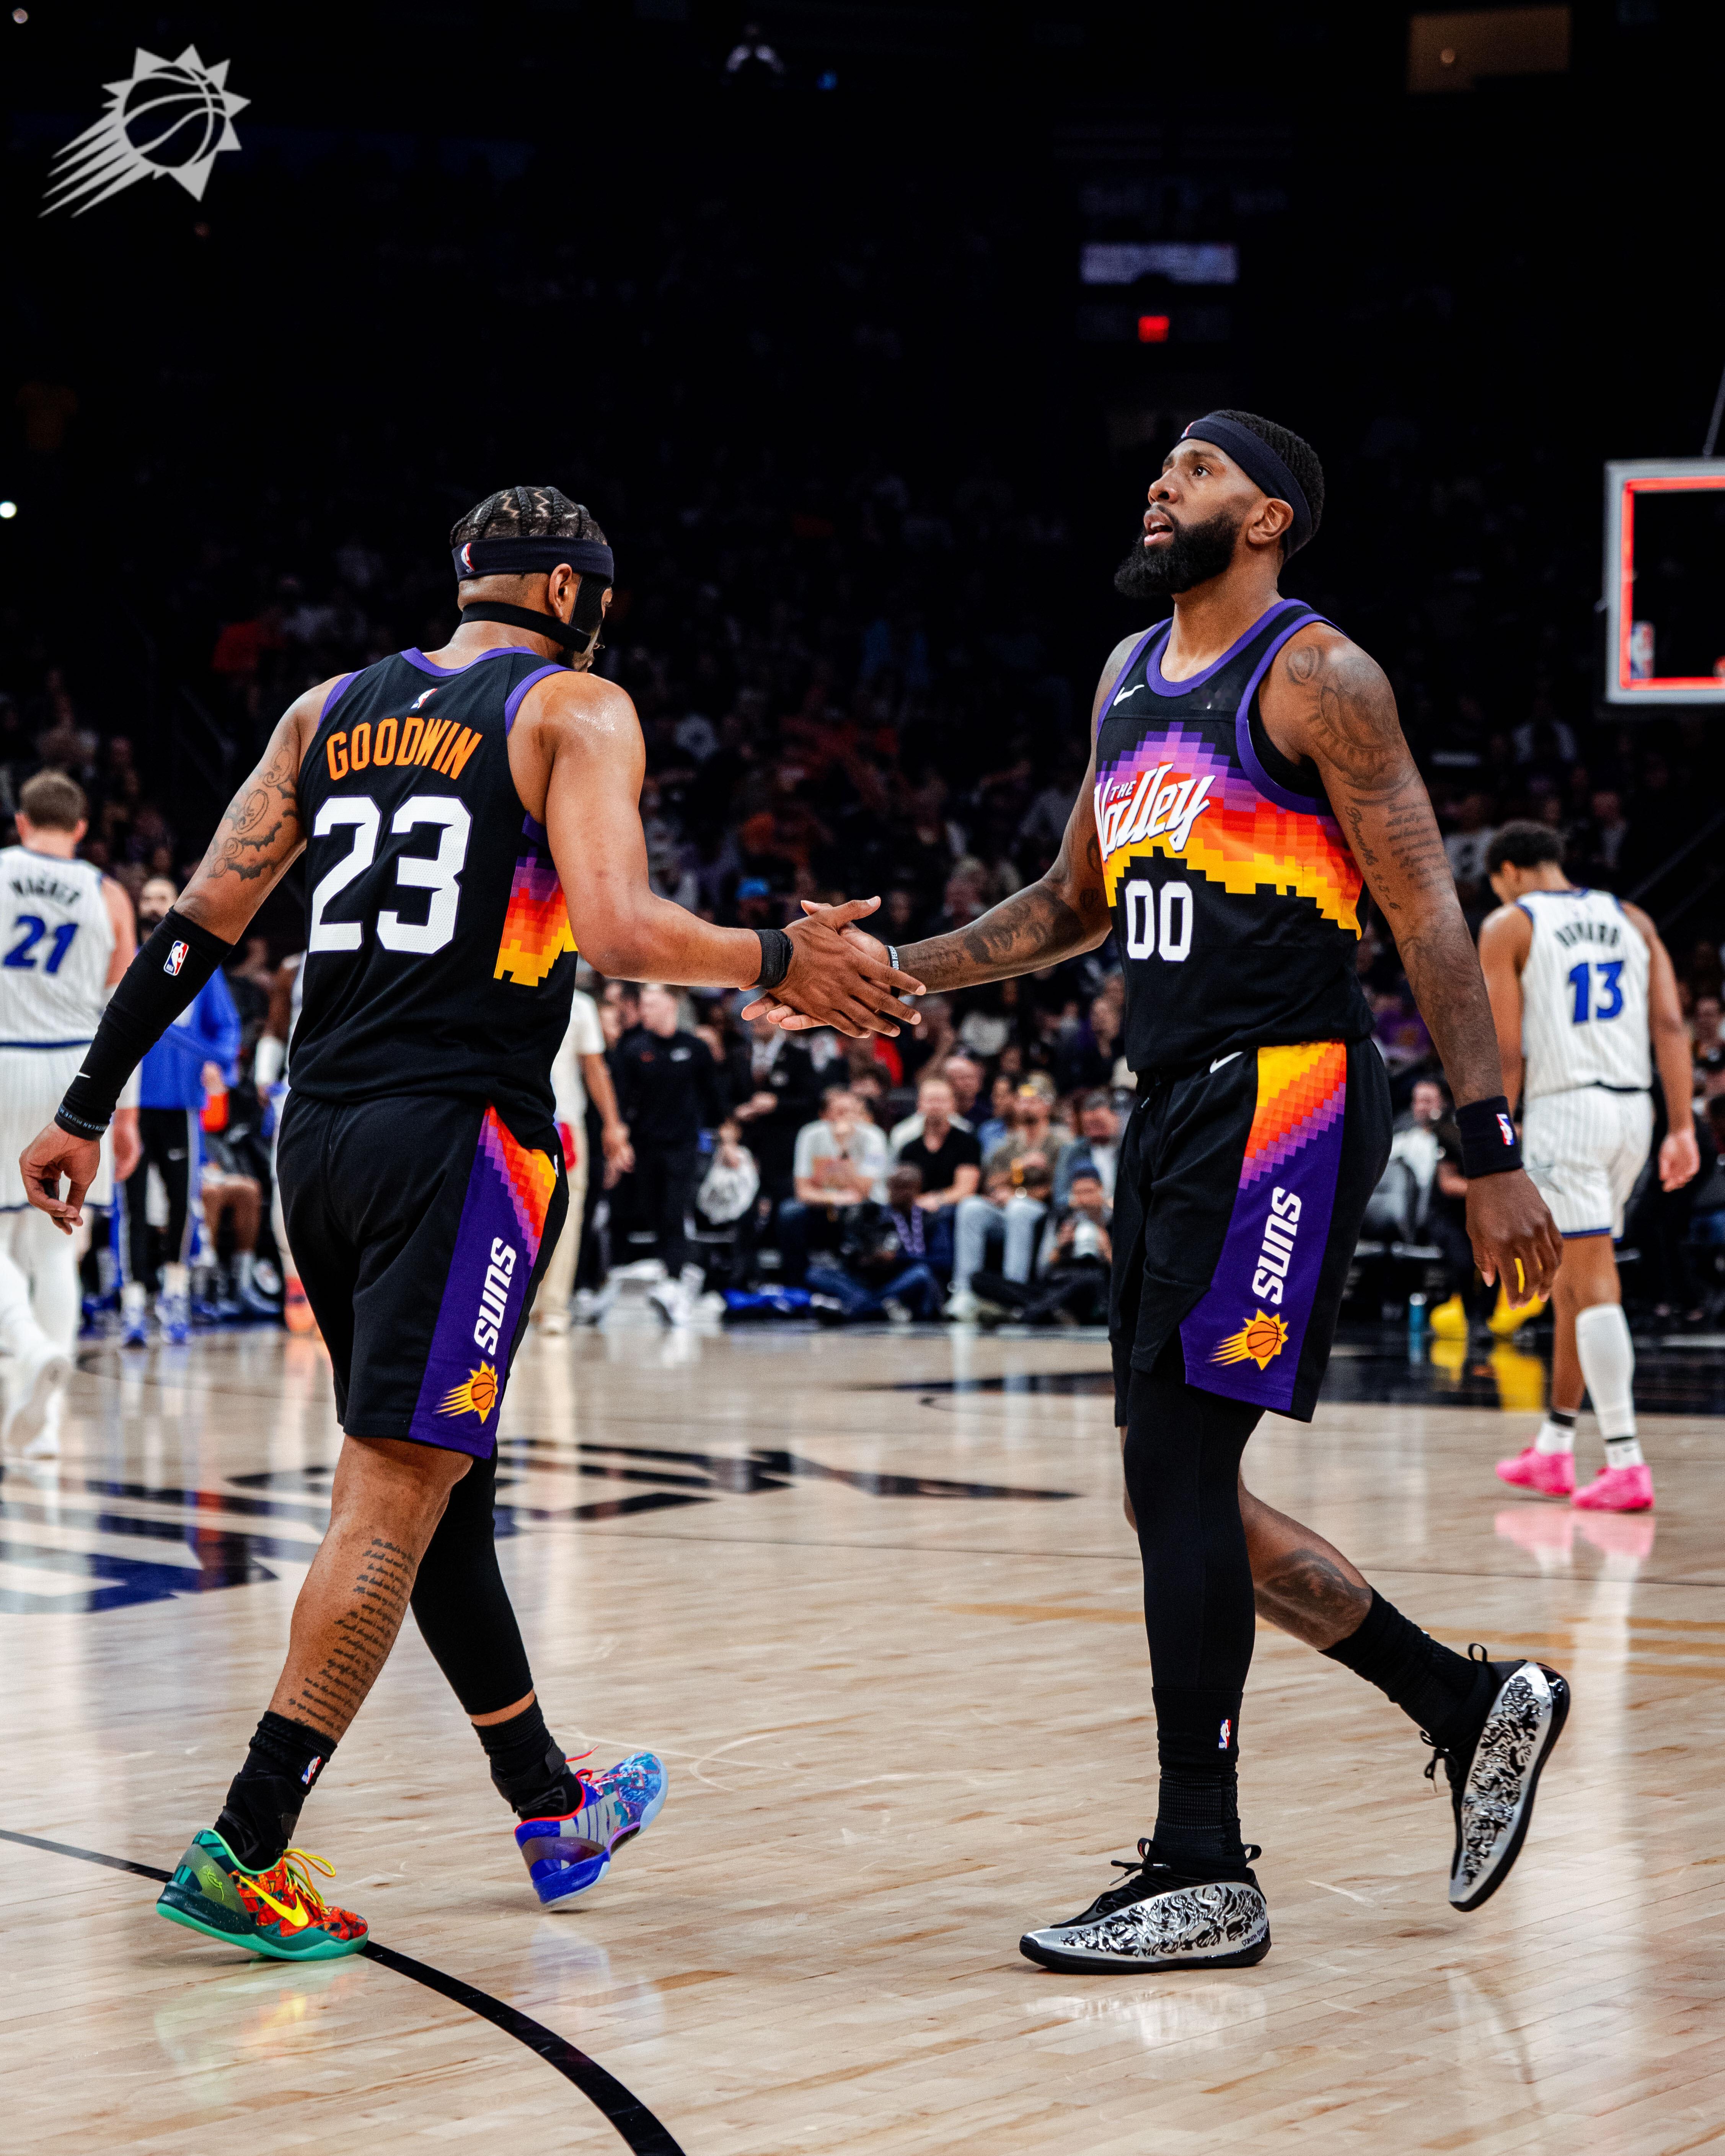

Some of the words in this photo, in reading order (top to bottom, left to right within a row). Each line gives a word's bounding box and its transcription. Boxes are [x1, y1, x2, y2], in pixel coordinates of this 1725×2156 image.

[326, 717, 483, 781] GOODWIN
[1110, 780, 1137, 801] THE
[1094, 764, 1216, 864] Valley
[308, 794, 473, 955] 23
[3, 914, 79, 976] 21
[1125, 878, 1193, 962] 00
[1568, 960, 1625, 1025] 13
[1251, 1186, 1303, 1305] SUNS
[474, 1237, 517, 1356] SUNS
